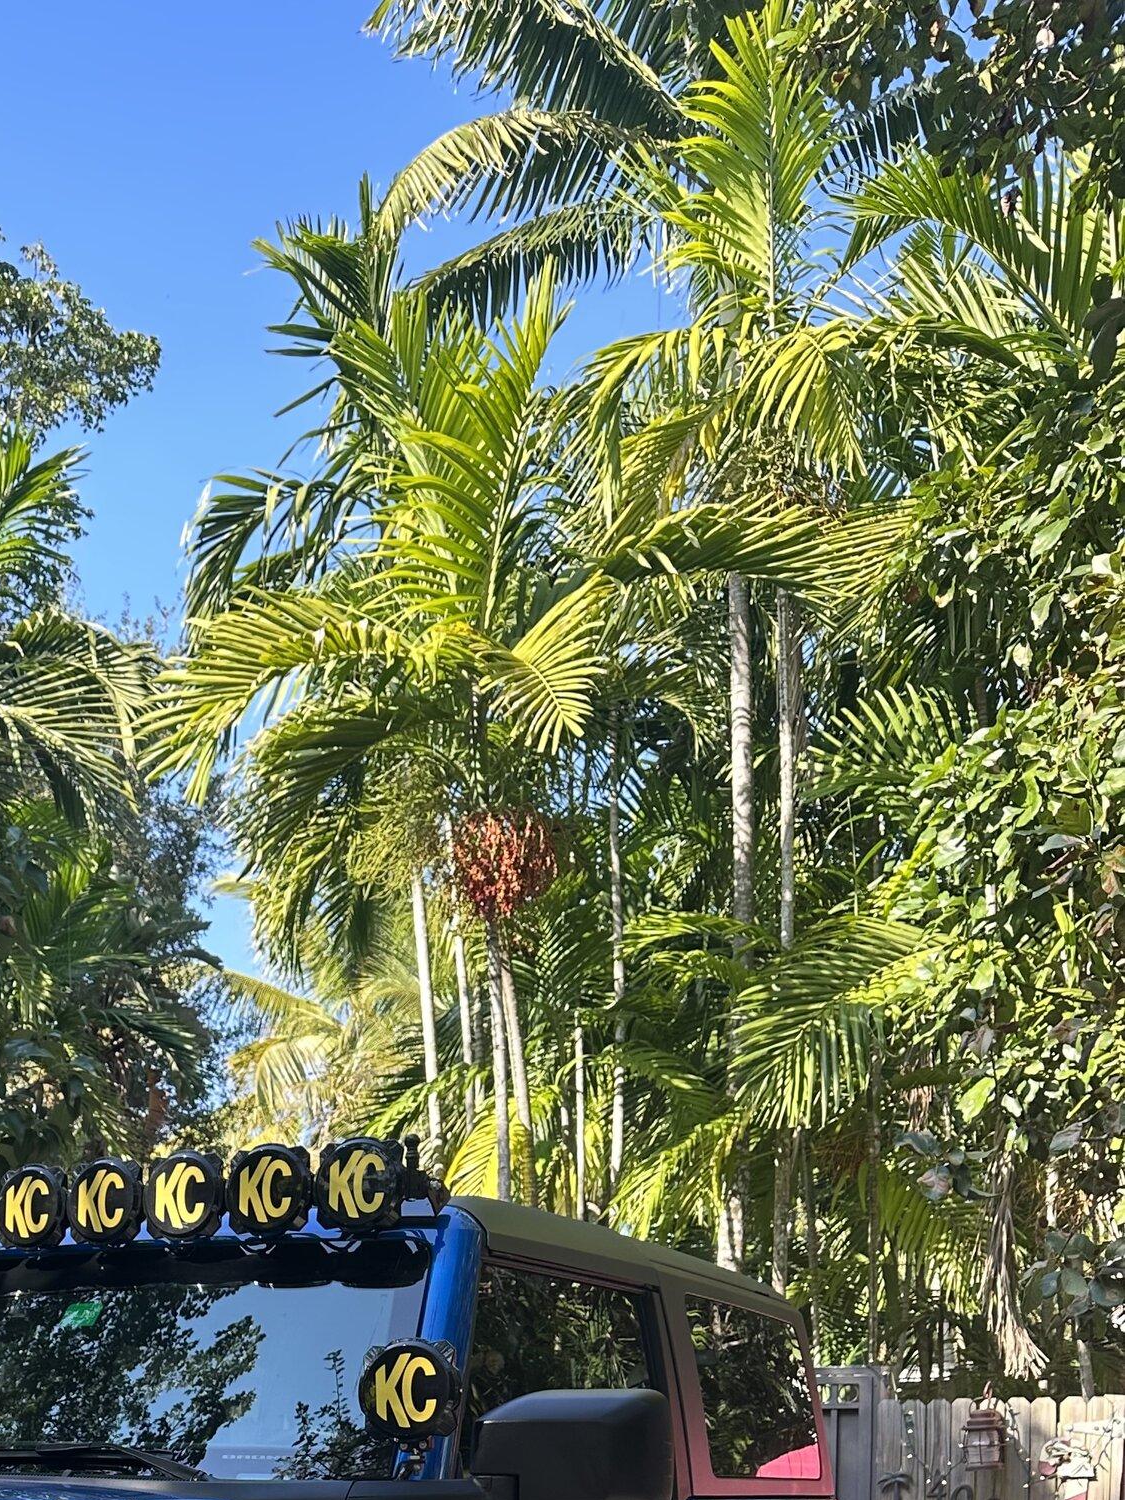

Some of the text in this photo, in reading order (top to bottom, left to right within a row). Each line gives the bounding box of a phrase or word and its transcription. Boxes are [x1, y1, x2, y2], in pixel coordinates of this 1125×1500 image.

[5, 1176, 49, 1239] KC
[77, 1169, 124, 1233] KC
[155, 1162, 205, 1229] KC
[239, 1156, 292, 1223] KC
[328, 1149, 386, 1219] KC
[375, 1352, 437, 1428] KC
